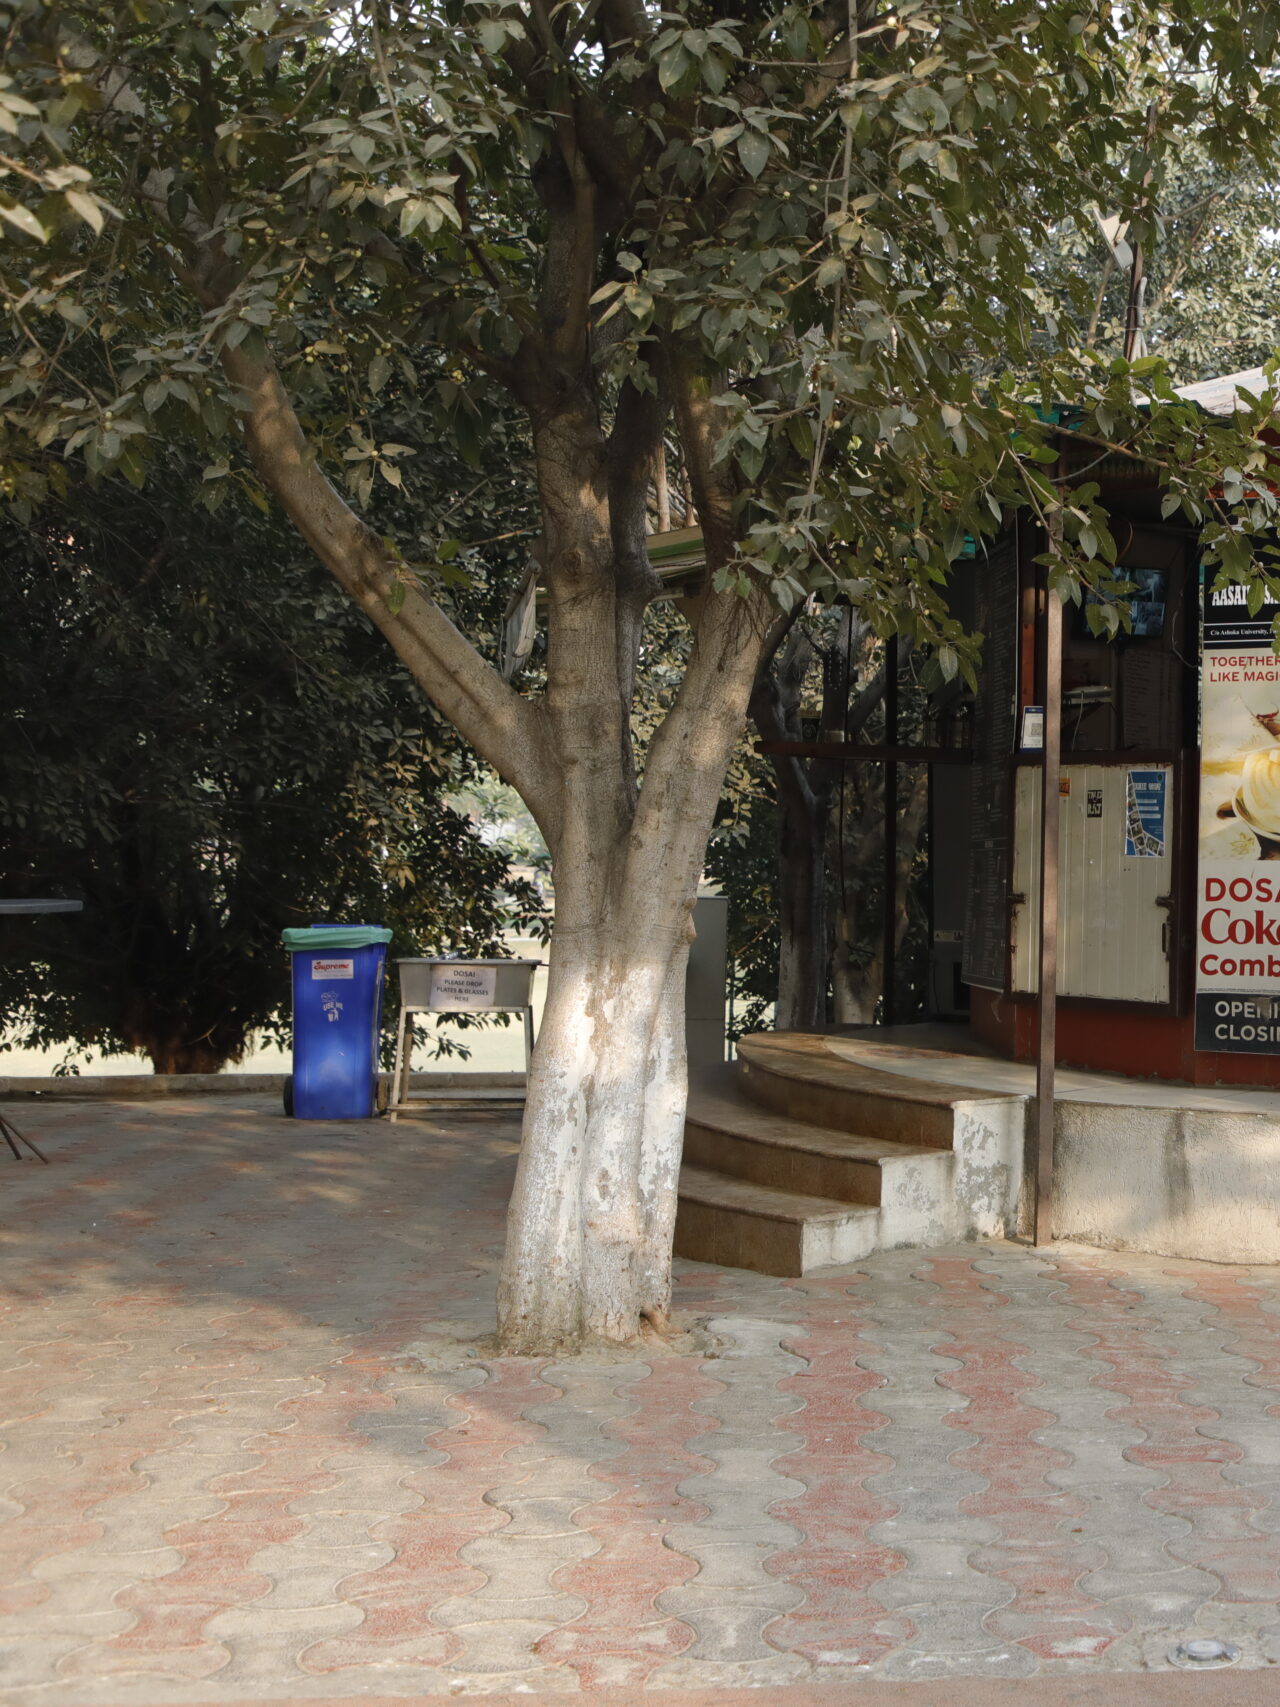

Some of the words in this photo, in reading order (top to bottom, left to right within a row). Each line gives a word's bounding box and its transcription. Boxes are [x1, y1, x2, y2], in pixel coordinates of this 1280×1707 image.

[1210, 671, 1240, 682] LIKE
[453, 970, 476, 978] DOSAI
[464, 988, 489, 996] GLASSES
